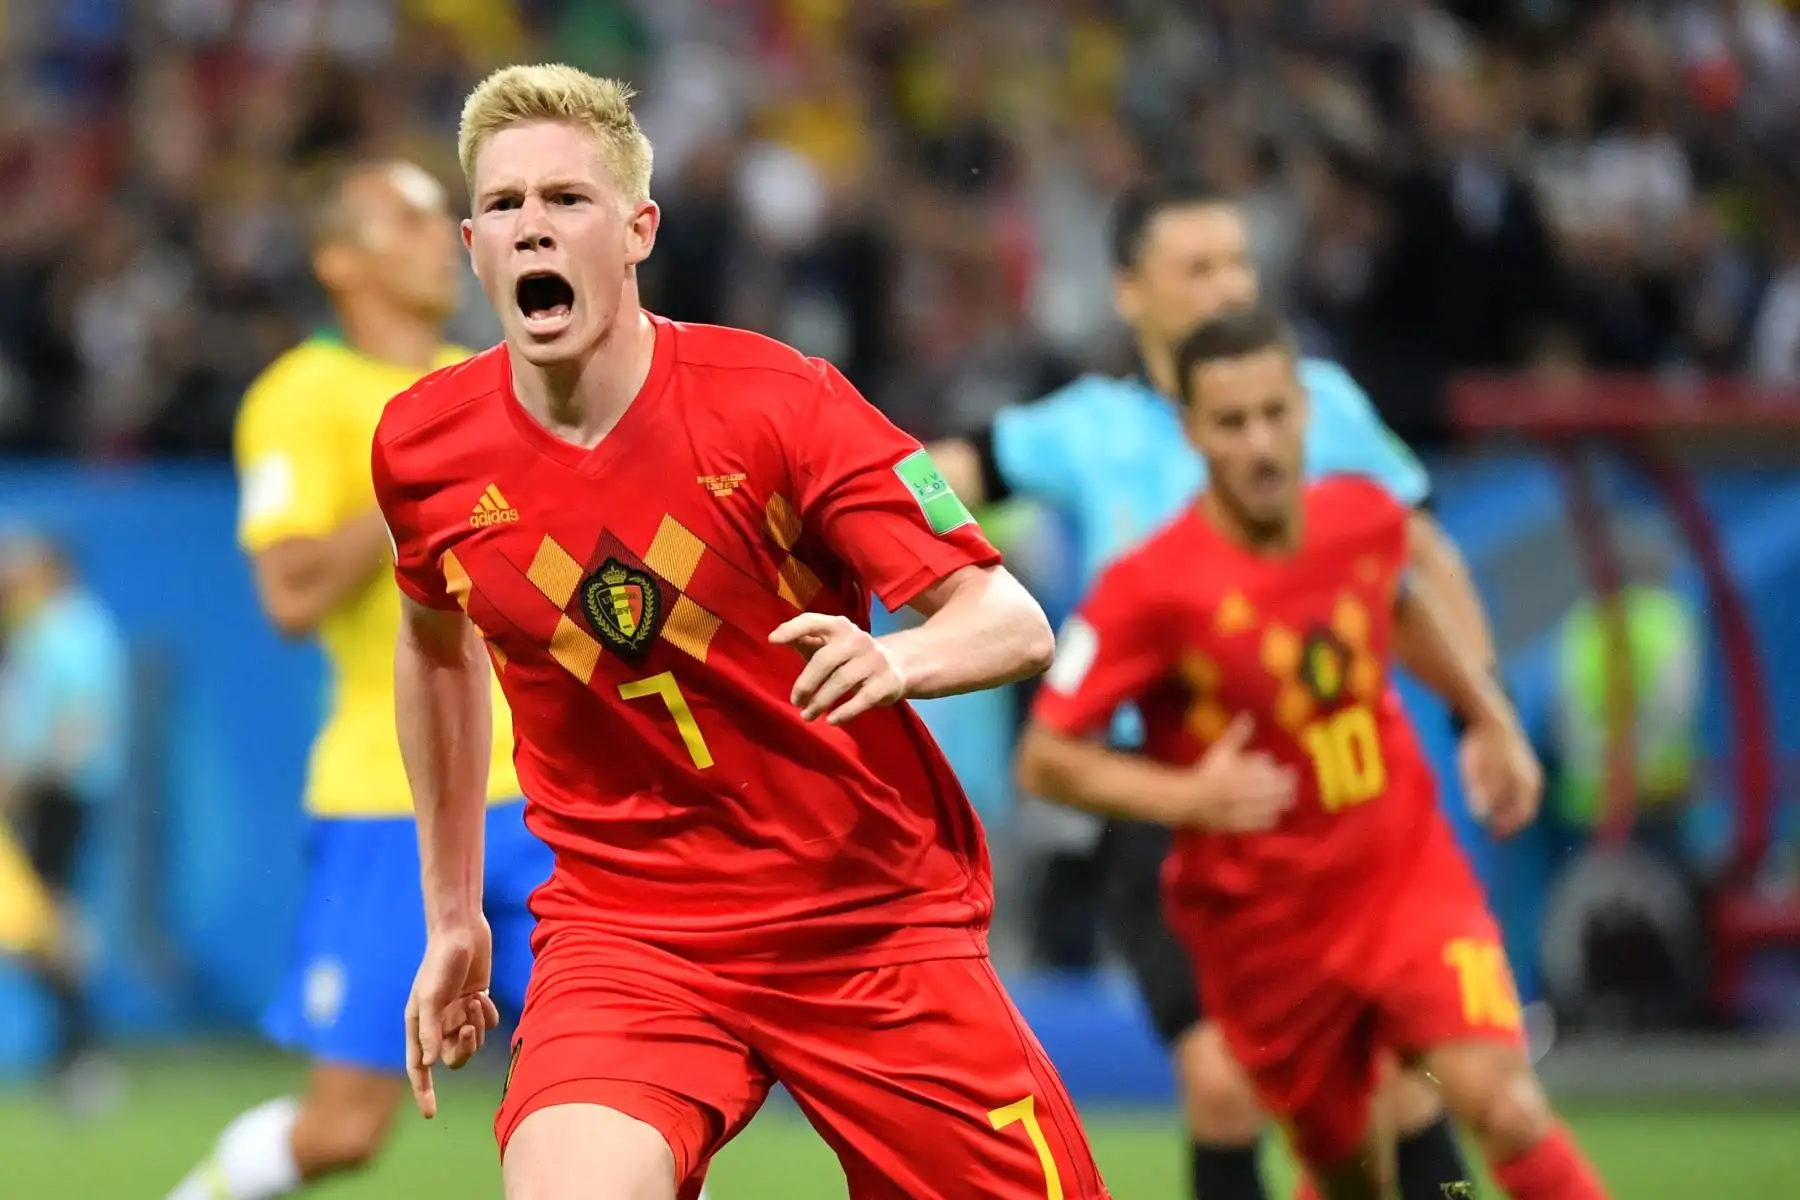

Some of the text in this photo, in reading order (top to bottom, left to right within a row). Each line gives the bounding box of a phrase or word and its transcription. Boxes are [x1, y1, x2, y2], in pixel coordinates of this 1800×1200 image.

[469, 508, 520, 528] adidas
[617, 670, 715, 770] 7
[1300, 705, 1385, 813] 10
[987, 1093, 1064, 1200] 7
